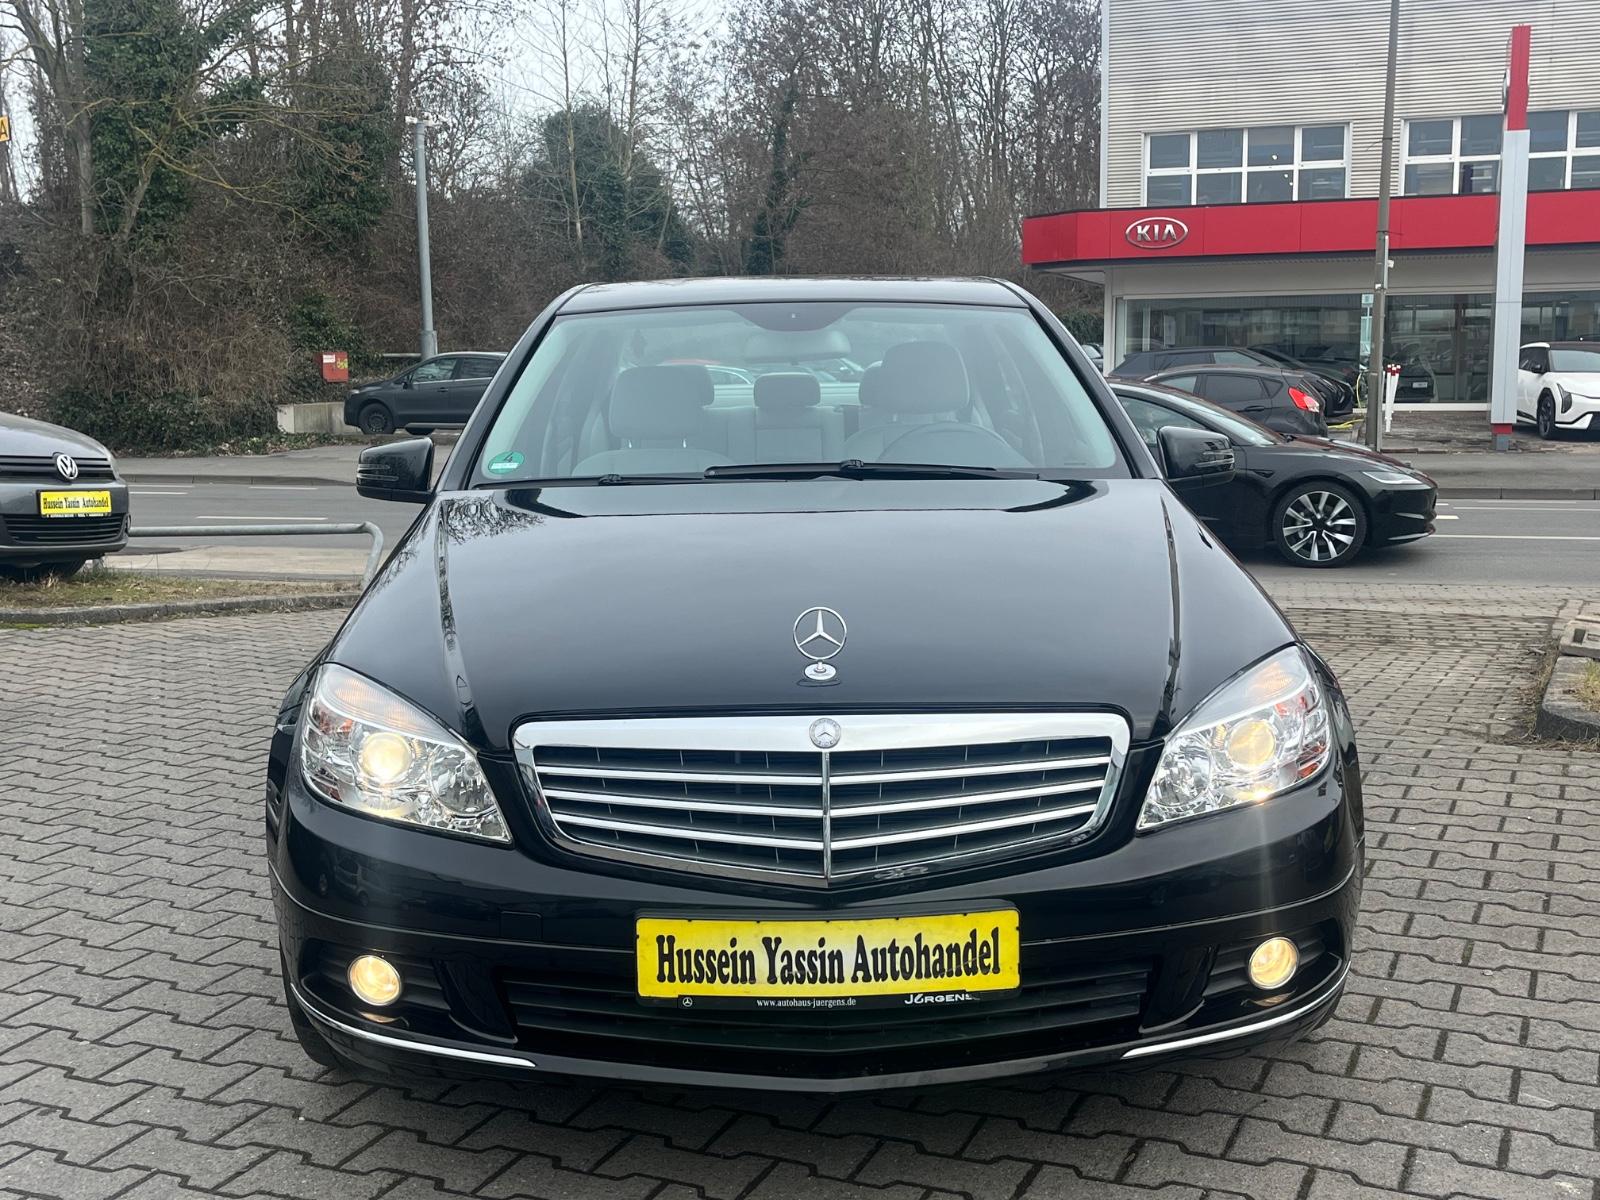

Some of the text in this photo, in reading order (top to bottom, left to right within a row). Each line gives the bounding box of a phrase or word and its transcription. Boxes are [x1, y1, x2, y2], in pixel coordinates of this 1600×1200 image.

[1137, 224, 1177, 241] KIA
[504, 452, 513, 463] 4
[43, 497, 109, 509] Hussein Yassin Autohandel
[656, 928, 1000, 985] Hussein Yassin Autohandel
[757, 998, 857, 1008] www.autohaus-juergens.de
